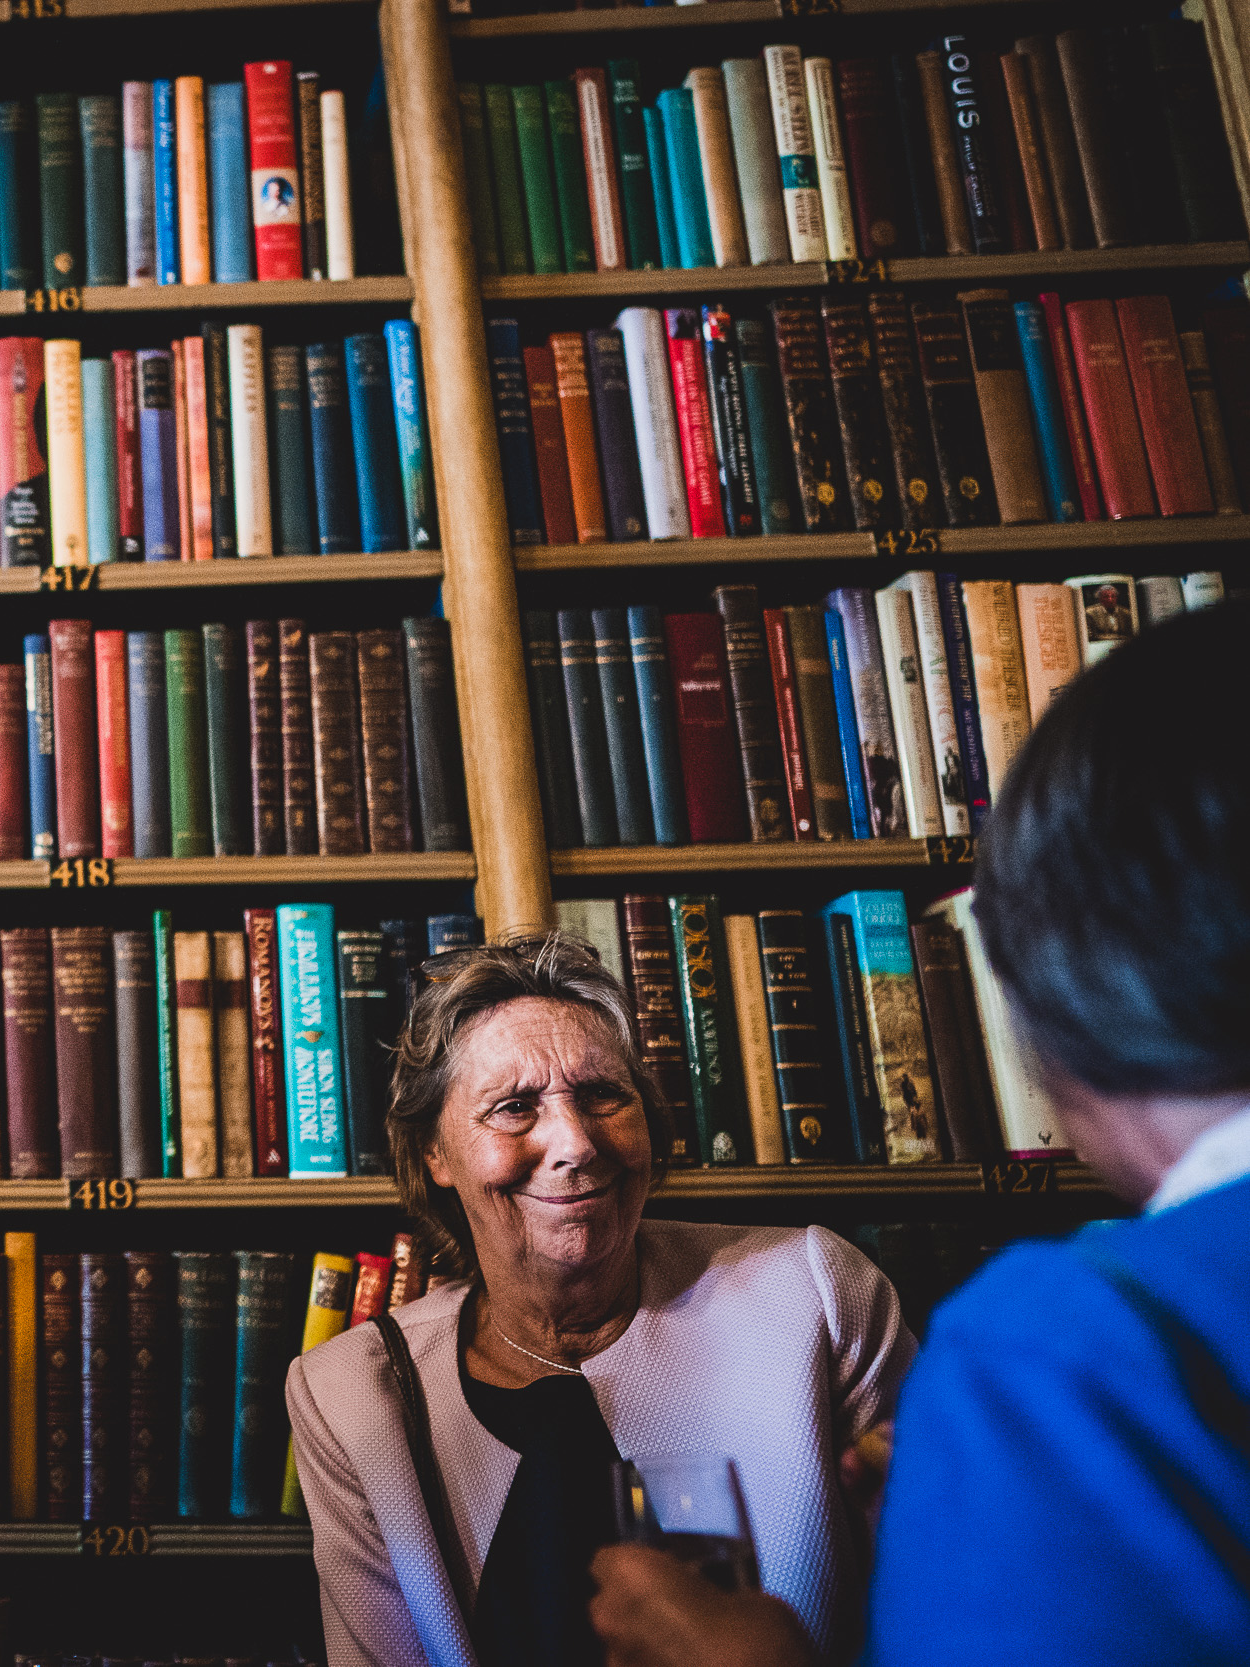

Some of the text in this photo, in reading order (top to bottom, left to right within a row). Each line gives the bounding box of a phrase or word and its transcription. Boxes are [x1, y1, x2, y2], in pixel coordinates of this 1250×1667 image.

[943, 34, 980, 129] LOUIS
[828, 259, 885, 283] 424
[27, 288, 81, 312] 416
[878, 529, 938, 554] 425
[41, 565, 96, 591] 417
[931, 838, 975, 864] 42
[51, 858, 110, 887] 418
[253, 917, 273, 1030] ROMANOVS
[989, 1163, 1050, 1192] 427
[73, 1180, 134, 1209] 419
[84, 1526, 149, 1556] 420
